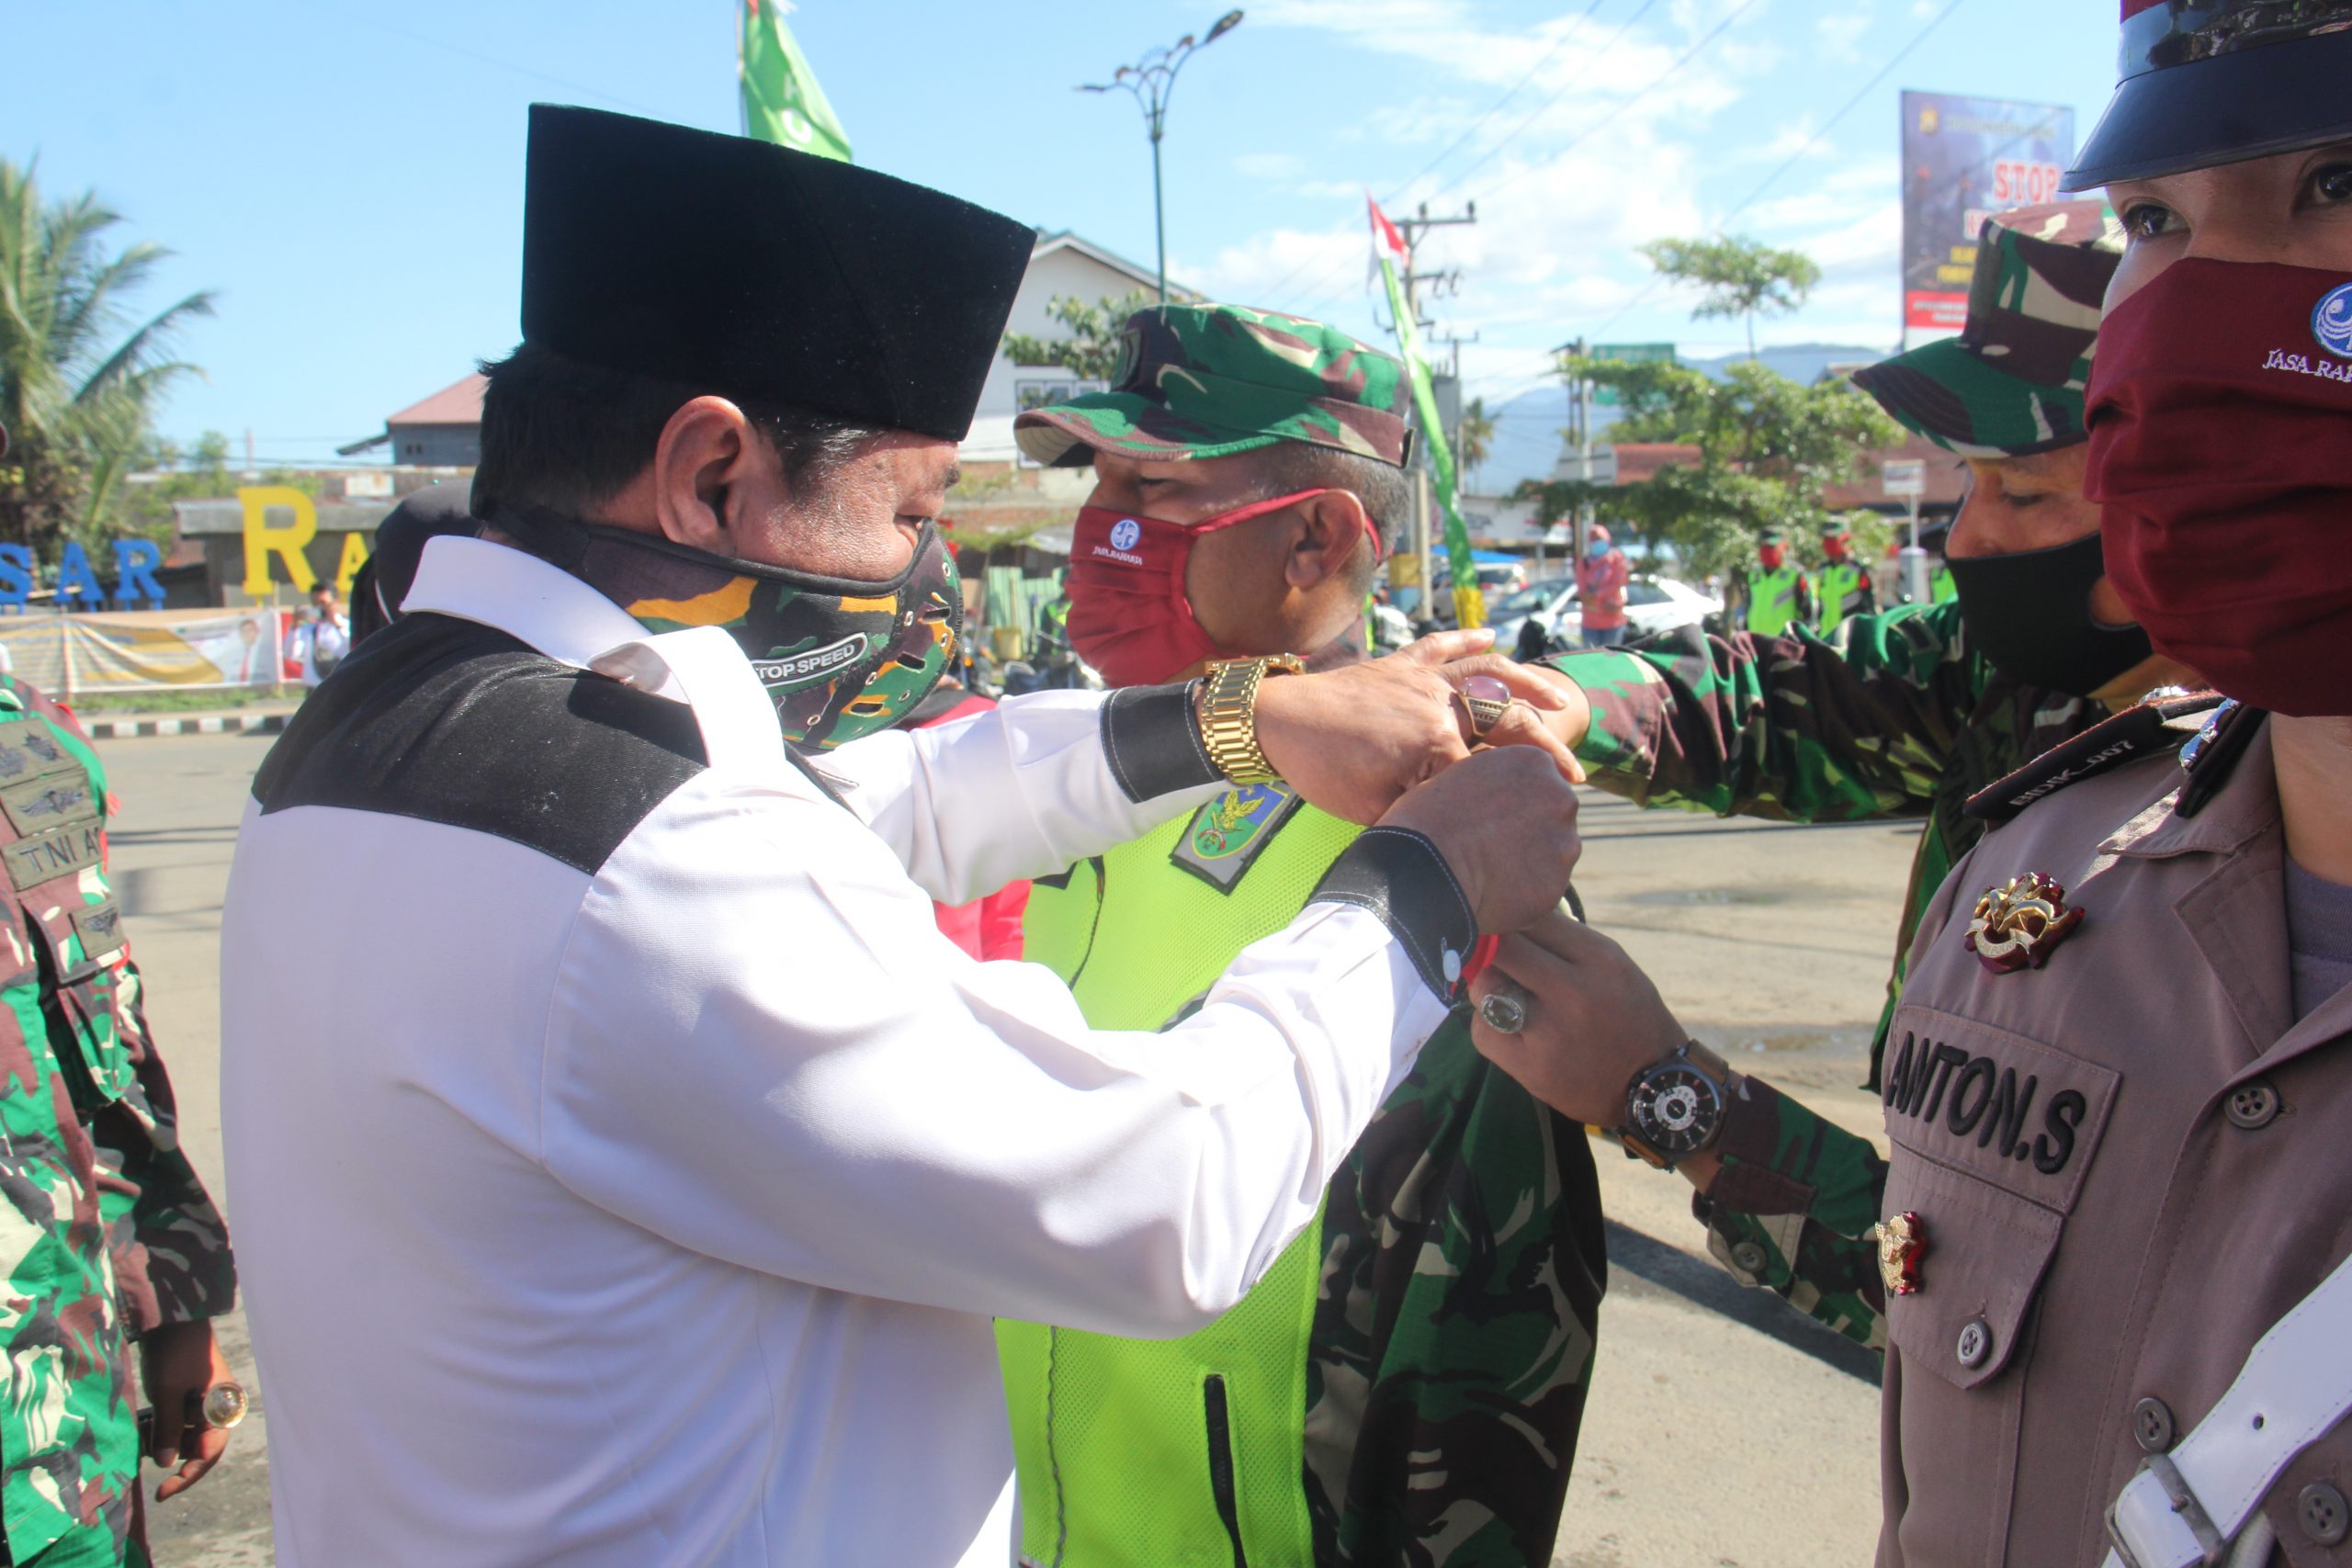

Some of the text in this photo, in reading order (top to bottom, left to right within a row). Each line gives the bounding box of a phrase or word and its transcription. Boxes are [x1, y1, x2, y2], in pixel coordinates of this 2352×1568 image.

[1994, 162, 2058, 204] STOP
[2262, 348, 2310, 374] JASA
[797, 643, 856, 674] SPEED
[18, 827, 100, 874] TNI A
[1885, 1030, 2086, 1175] ANTON.S
